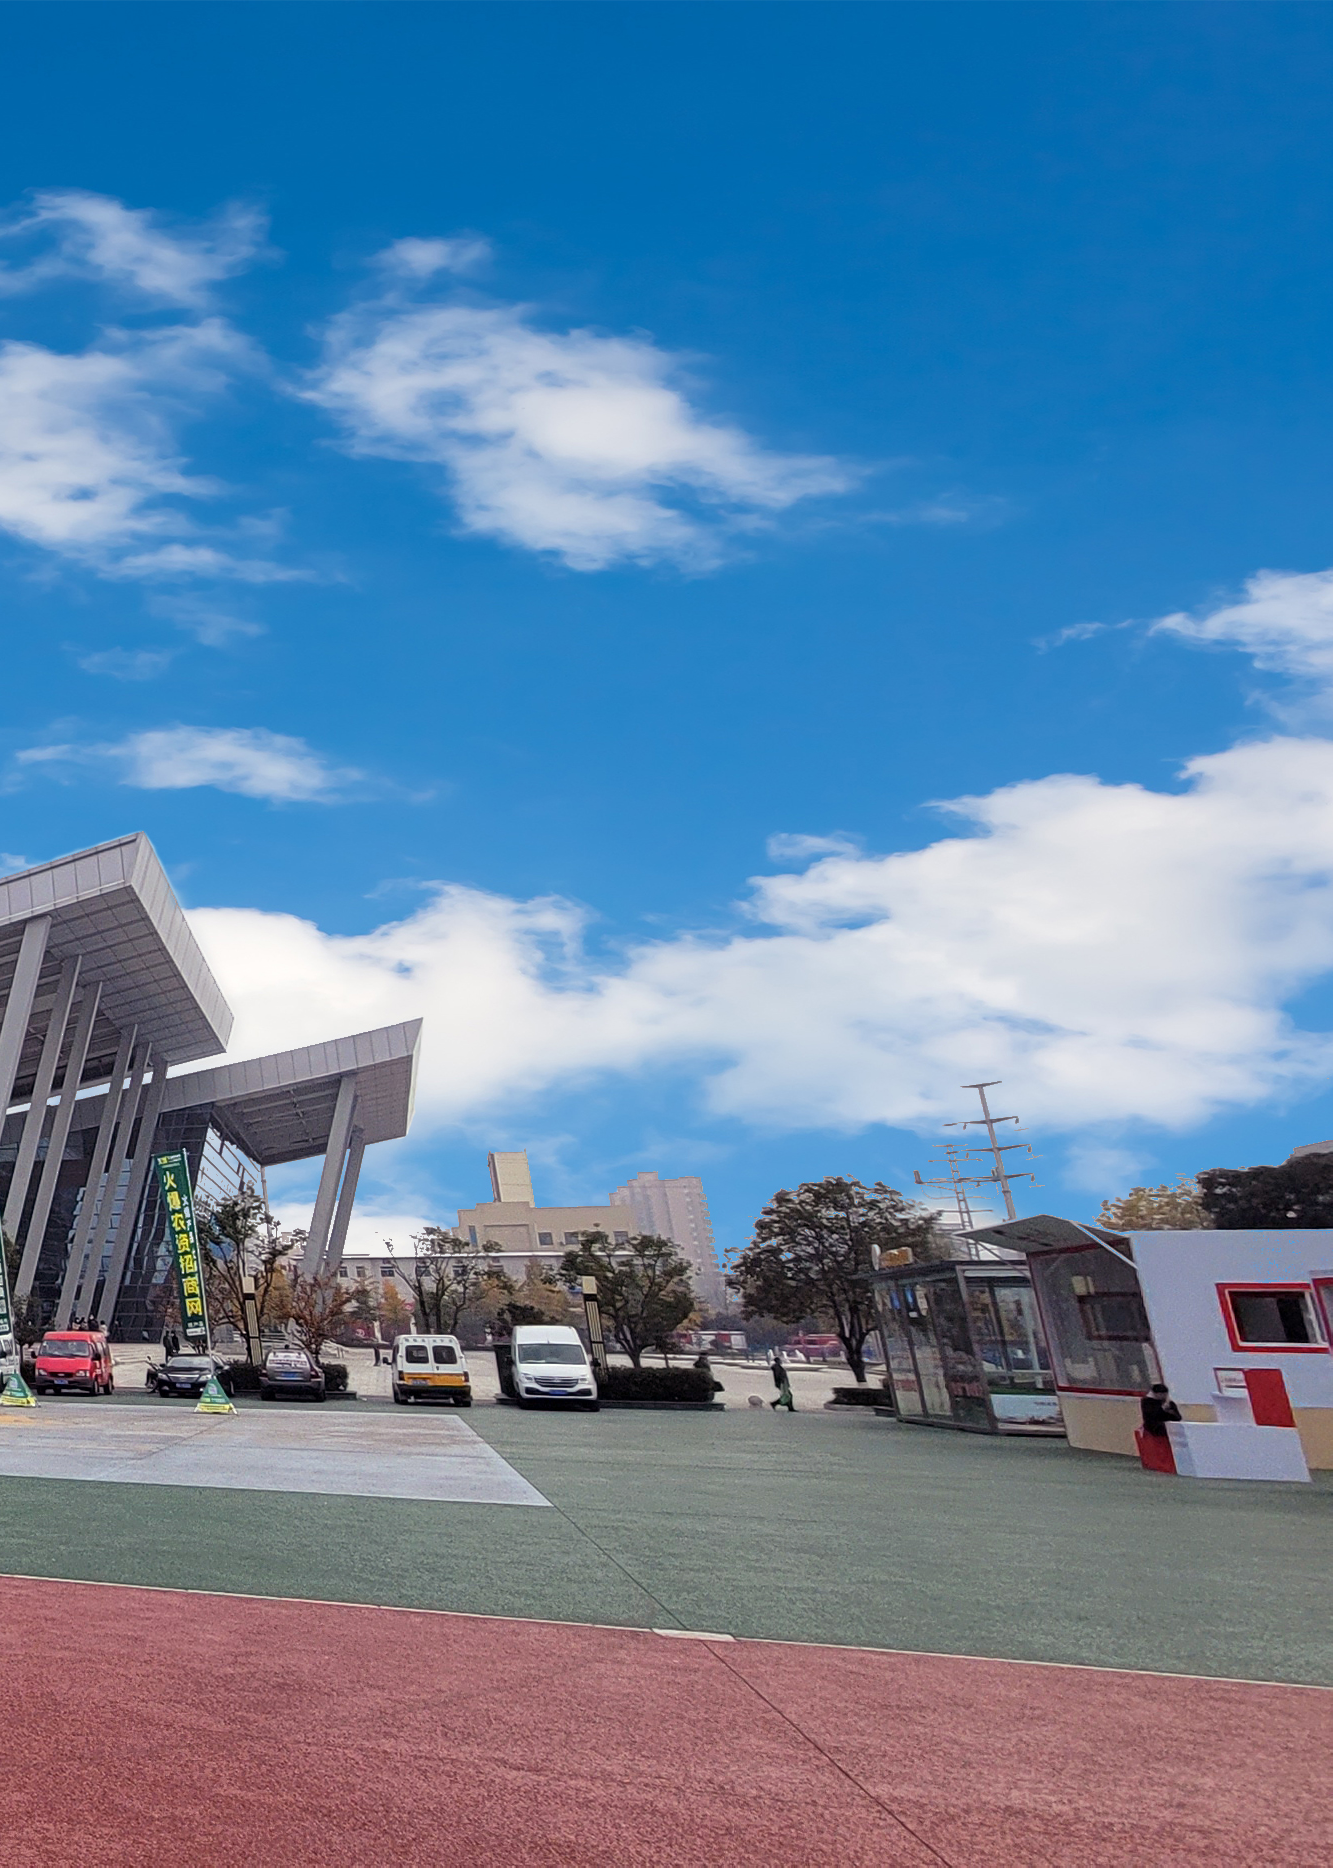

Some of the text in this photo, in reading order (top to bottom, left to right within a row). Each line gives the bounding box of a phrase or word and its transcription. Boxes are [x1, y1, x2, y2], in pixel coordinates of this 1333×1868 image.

[163, 1171, 203, 1317] 火爆农资招商网
